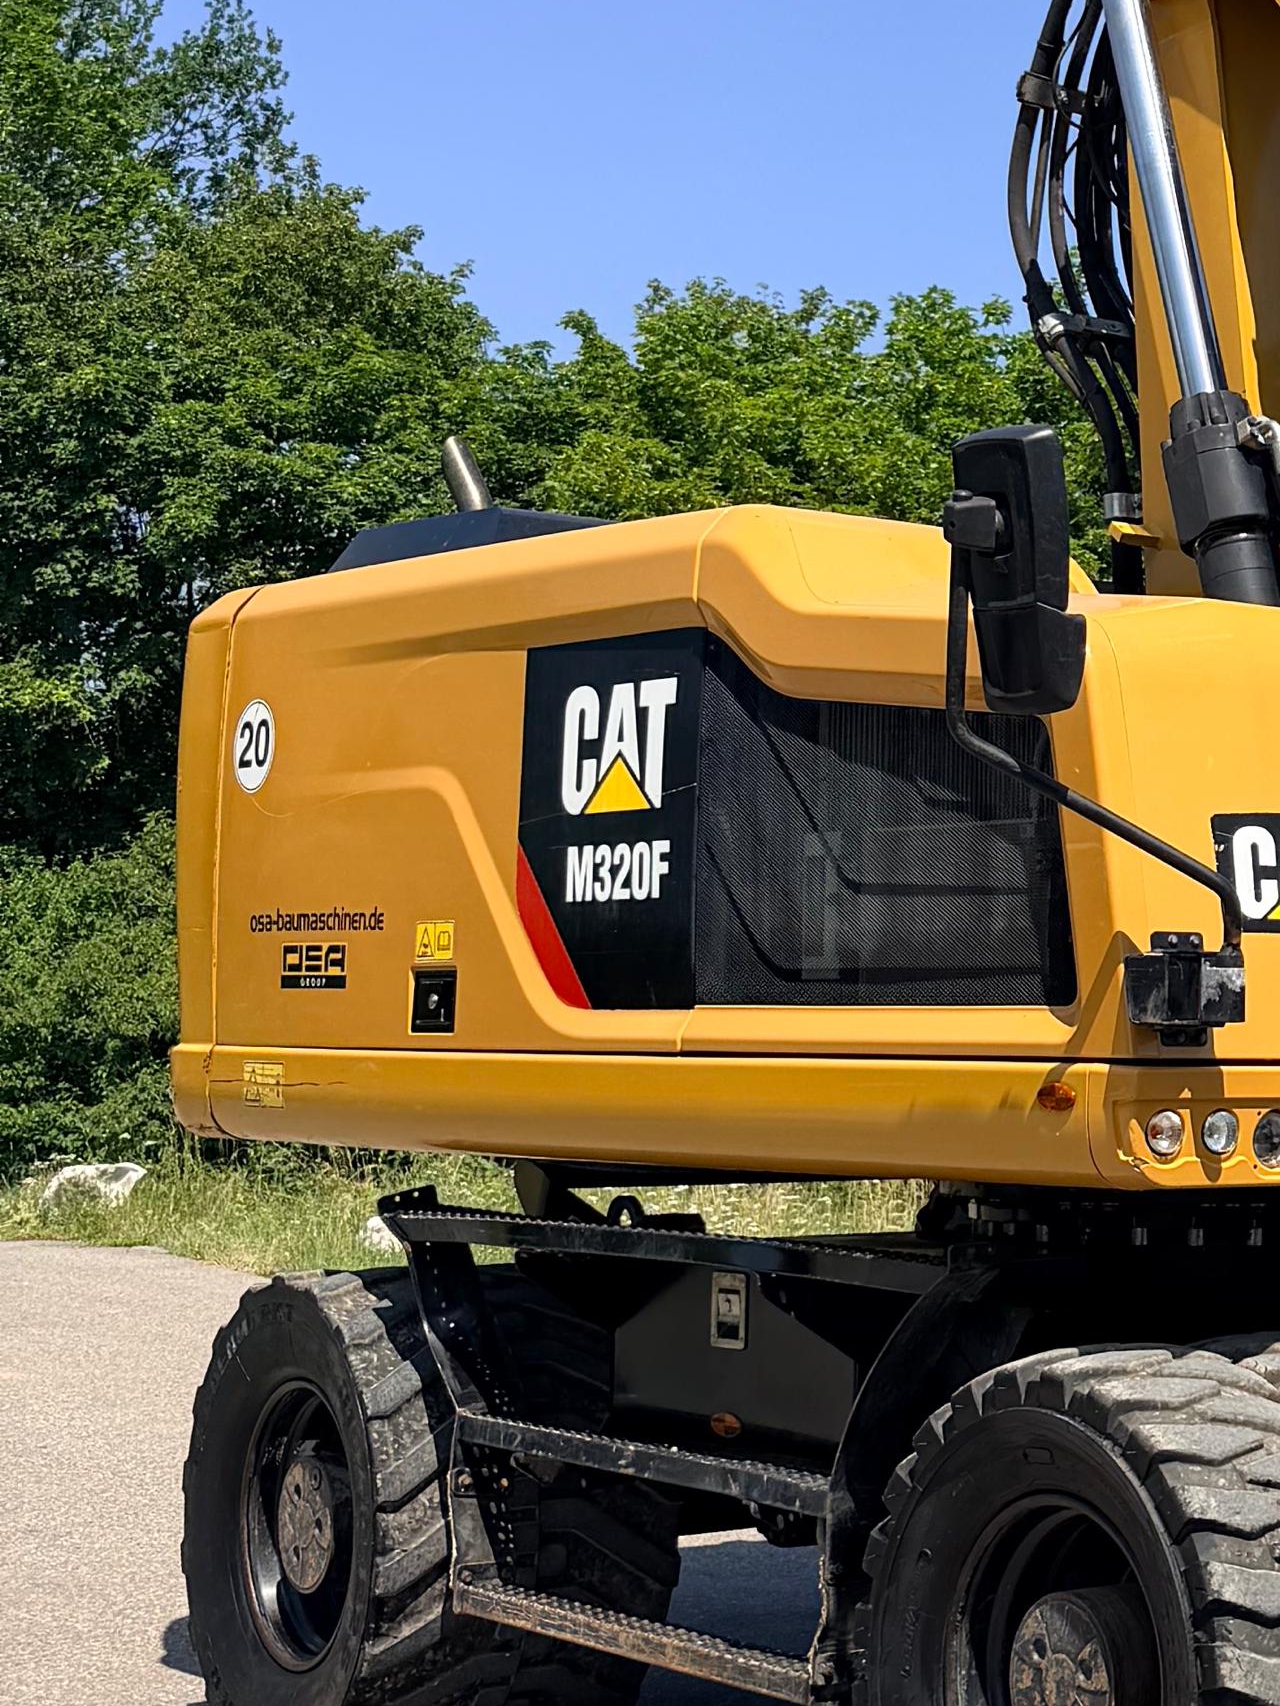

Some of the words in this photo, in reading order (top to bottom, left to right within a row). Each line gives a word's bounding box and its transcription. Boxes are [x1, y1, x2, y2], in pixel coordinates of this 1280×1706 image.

[238, 718, 270, 769] 20
[561, 677, 678, 816] CAT
[565, 840, 670, 903] M320F
[250, 905, 385, 933] osa-baumaschinen.de
